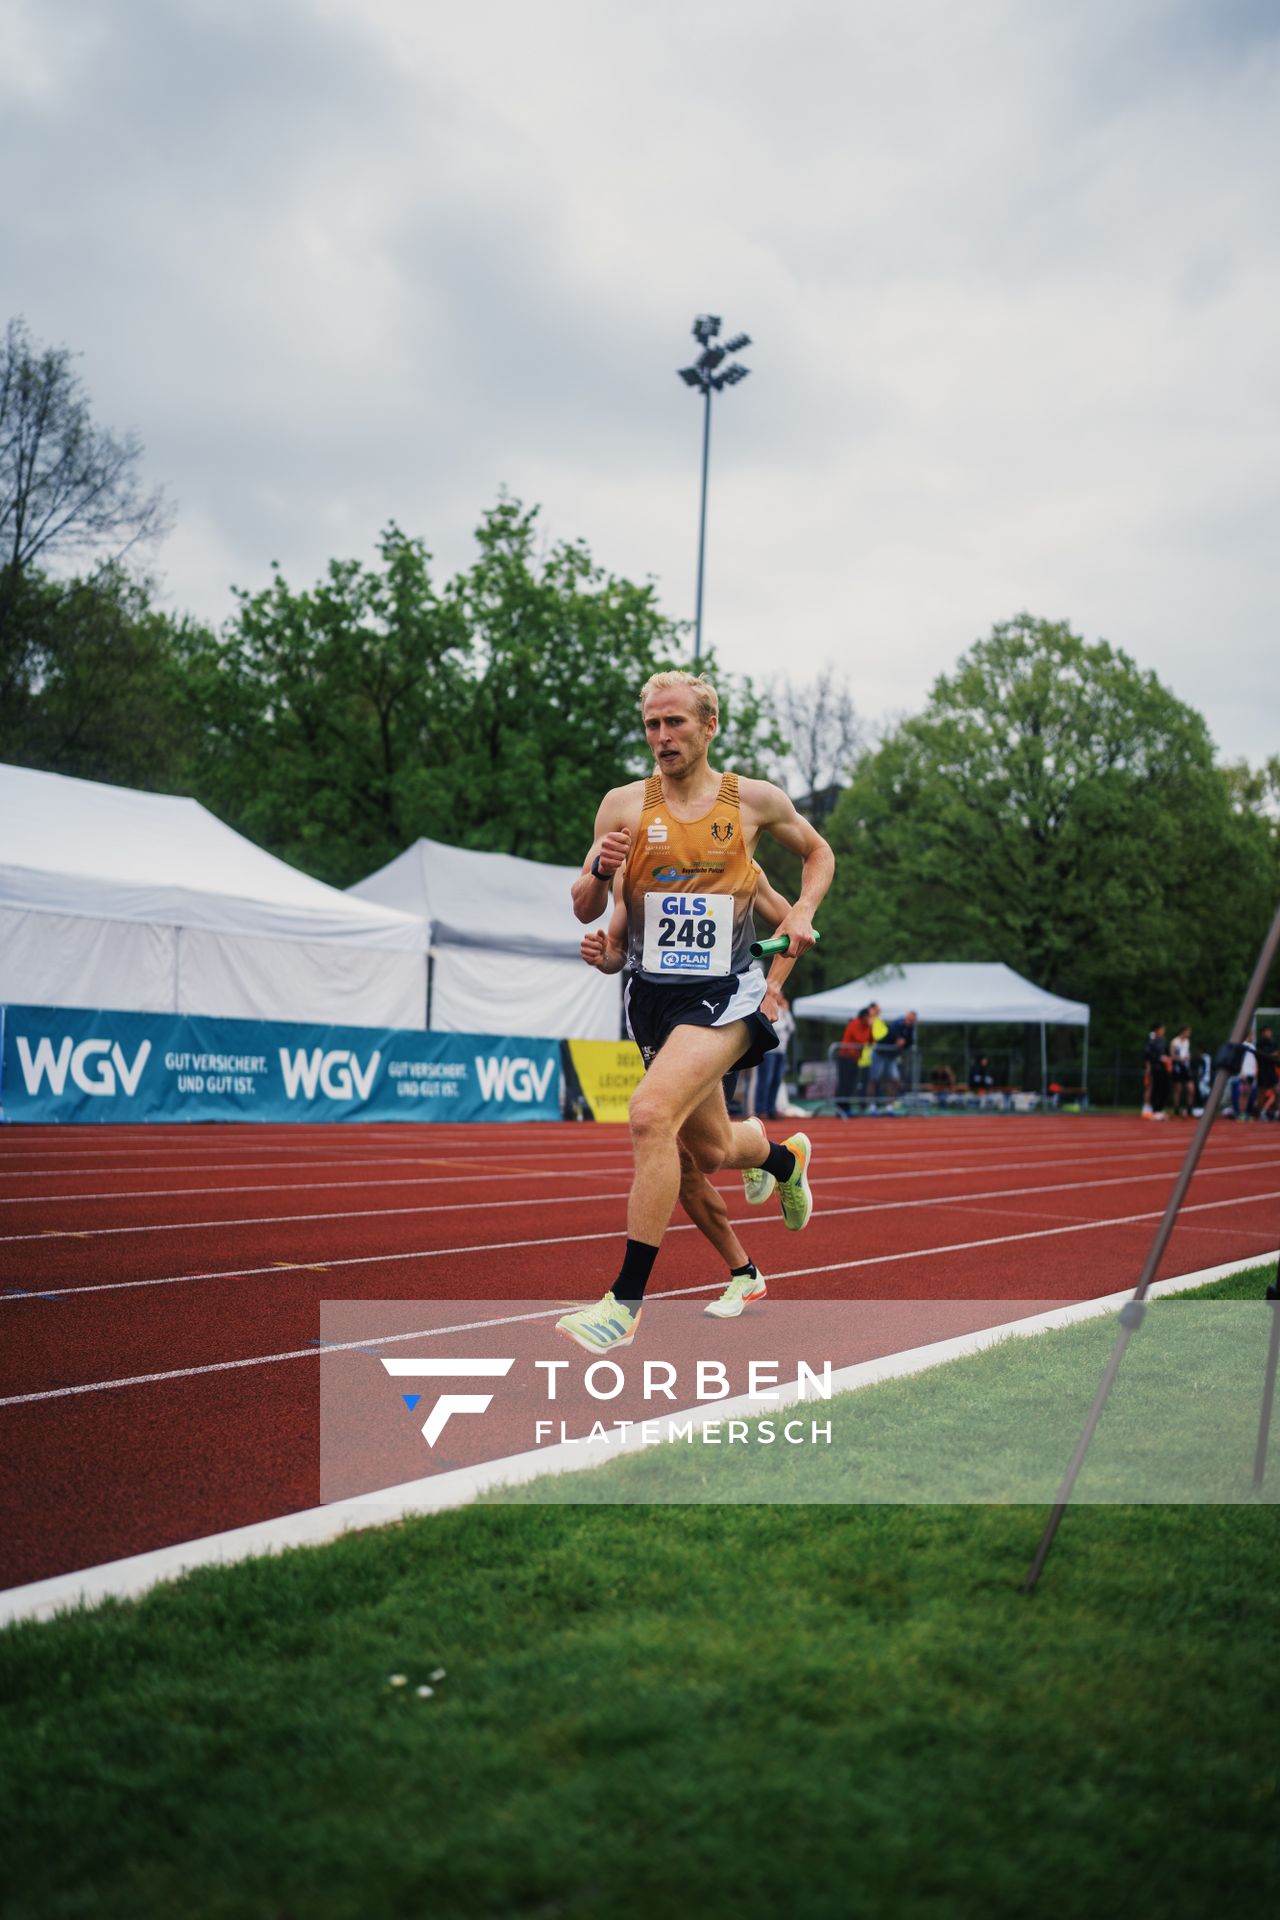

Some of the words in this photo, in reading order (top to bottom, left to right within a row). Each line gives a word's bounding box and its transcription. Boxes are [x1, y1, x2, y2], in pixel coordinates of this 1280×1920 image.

[658, 918, 716, 949] 248
[680, 954, 708, 964] PLAN
[16, 1036, 151, 1096] WGV
[165, 1052, 190, 1071] GUT
[192, 1054, 267, 1074] VERSICHERT.
[279, 1048, 381, 1101] WGV
[178, 1075, 204, 1093] UND
[206, 1076, 232, 1094] GUT
[475, 1056, 555, 1102] WGV
